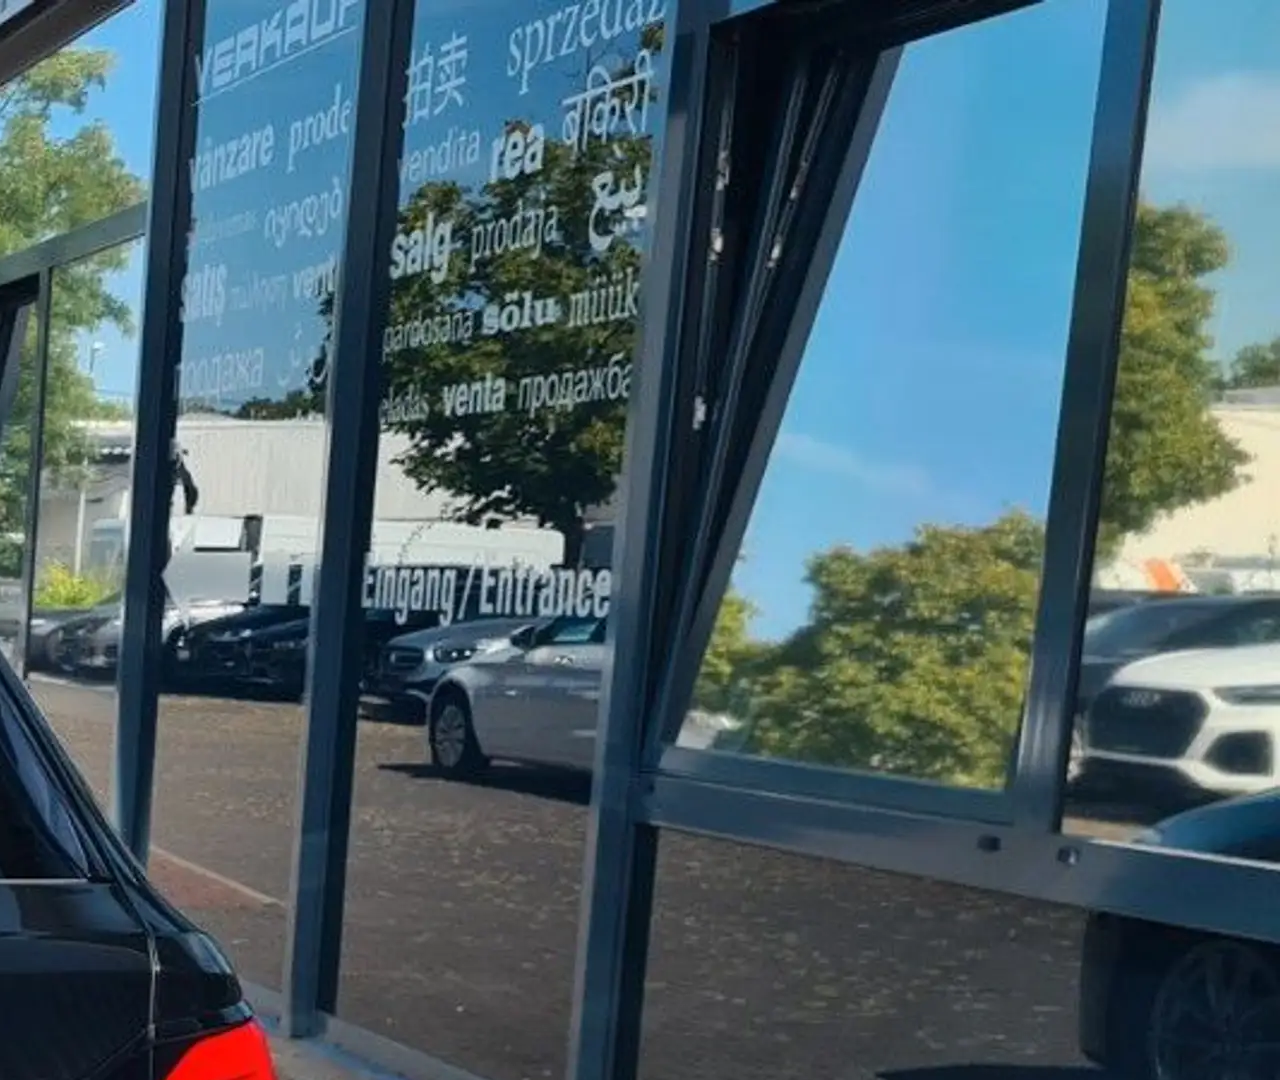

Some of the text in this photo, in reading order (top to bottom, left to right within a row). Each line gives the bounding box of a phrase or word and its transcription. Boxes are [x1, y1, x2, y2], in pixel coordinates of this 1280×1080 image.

[489, 124, 544, 183] rea
[390, 212, 460, 284] salg
[443, 372, 507, 418] venta
[361, 552, 456, 626] Eingang
[478, 553, 612, 619] Entrance
